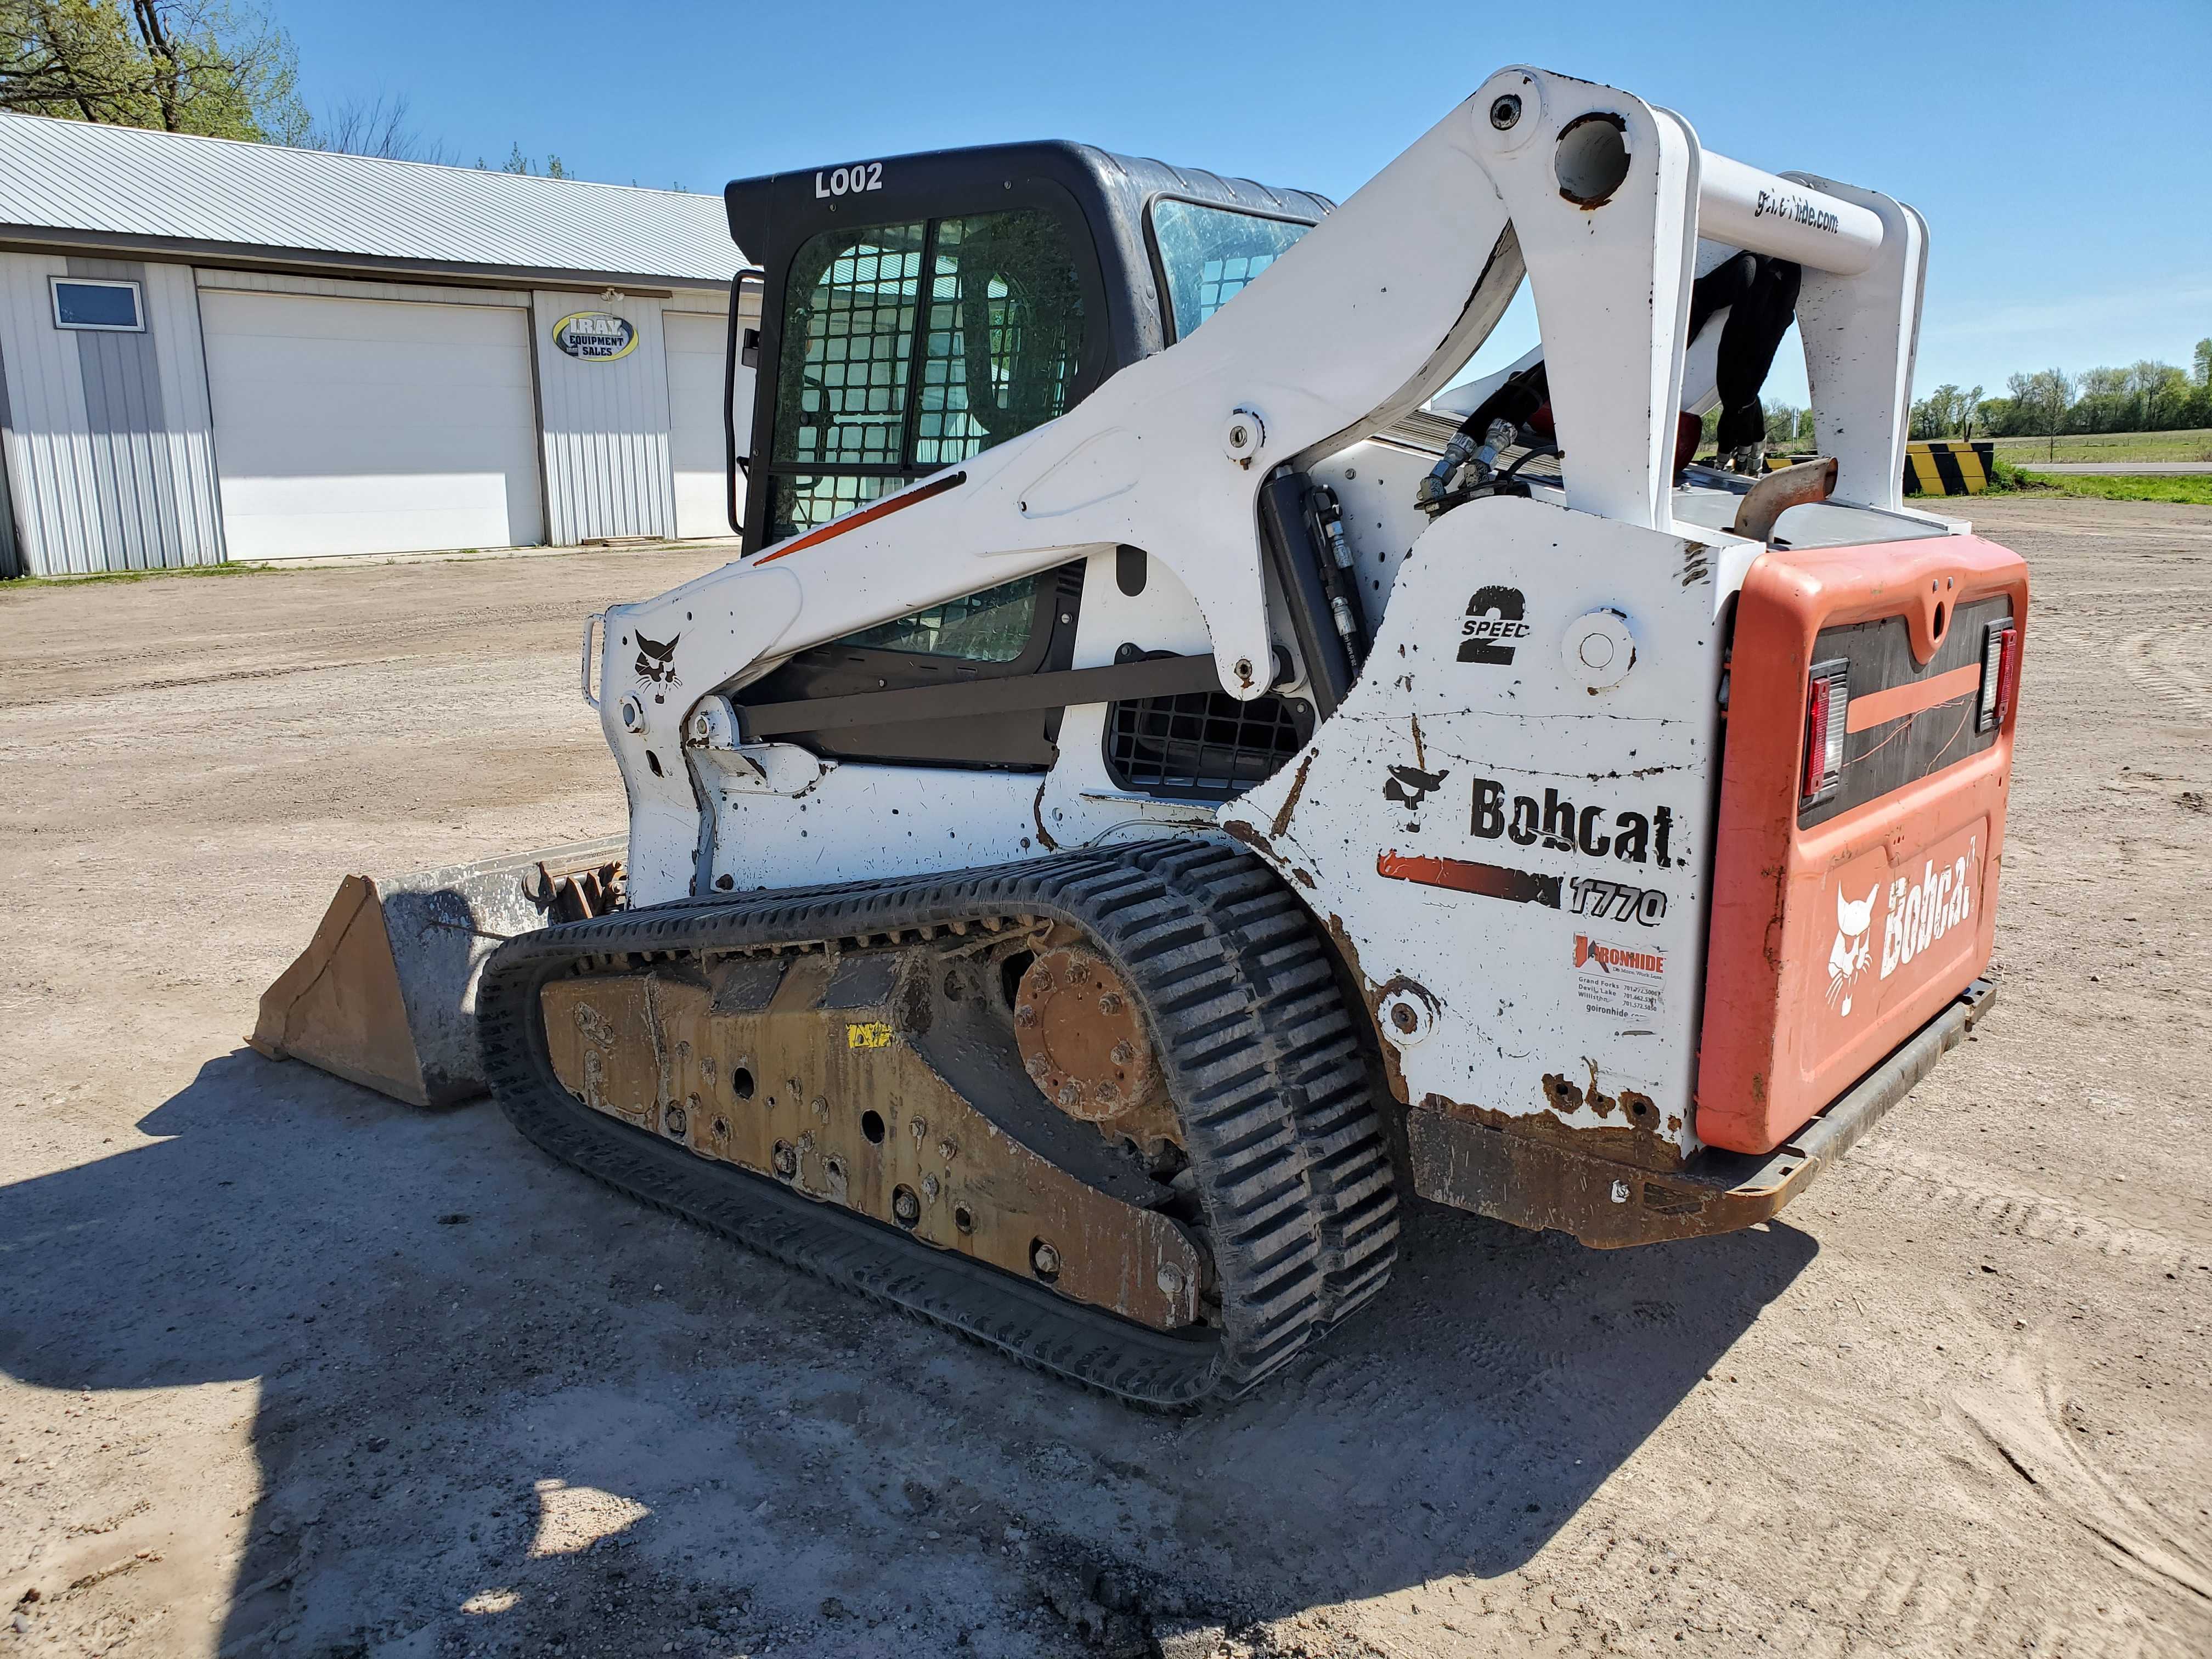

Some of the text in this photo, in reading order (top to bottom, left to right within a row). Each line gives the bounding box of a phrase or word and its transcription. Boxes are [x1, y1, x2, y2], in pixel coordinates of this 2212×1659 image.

[569, 335, 624, 346] EQUIPMENT
[582, 346, 612, 356] SALES
[1470, 777, 1672, 868] Bobcat
[1578, 977, 1599, 985] Grand
[1601, 980, 1620, 989] Forks
